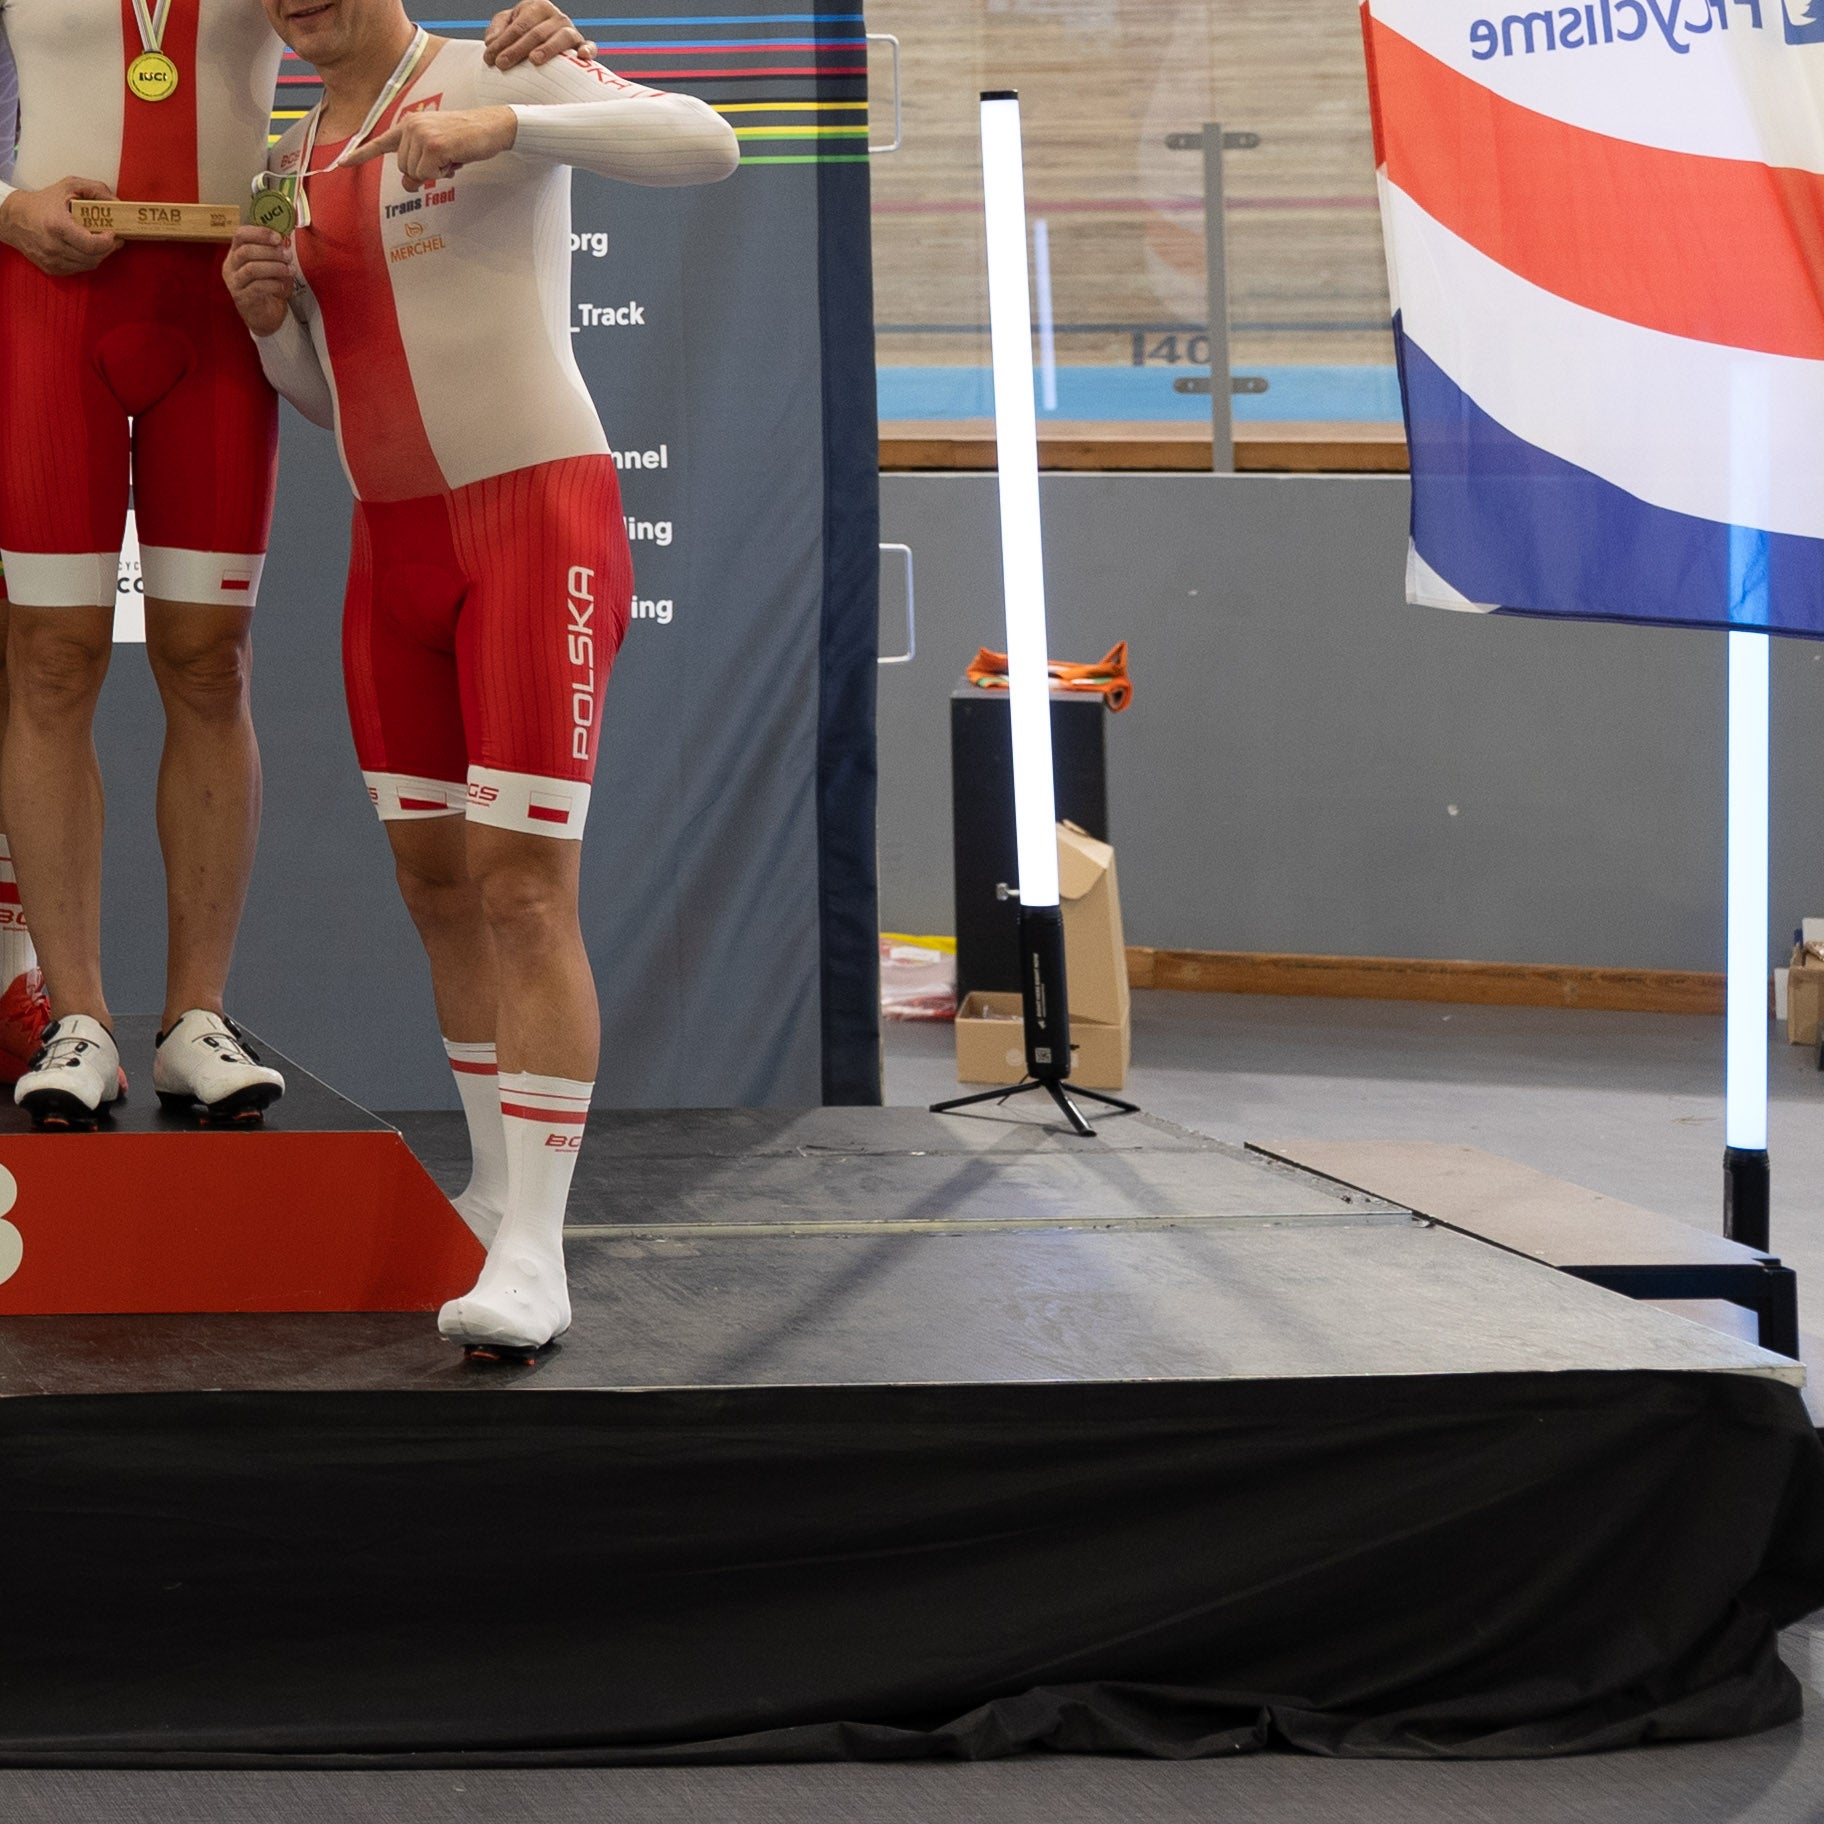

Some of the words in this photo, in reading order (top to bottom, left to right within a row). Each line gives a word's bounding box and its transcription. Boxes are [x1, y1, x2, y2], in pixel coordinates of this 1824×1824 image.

[138, 208, 182, 223] STAB
[385, 197, 423, 220] Trans
[390, 237, 447, 264] MERCHEL
[566, 565, 595, 761] POLSKA
